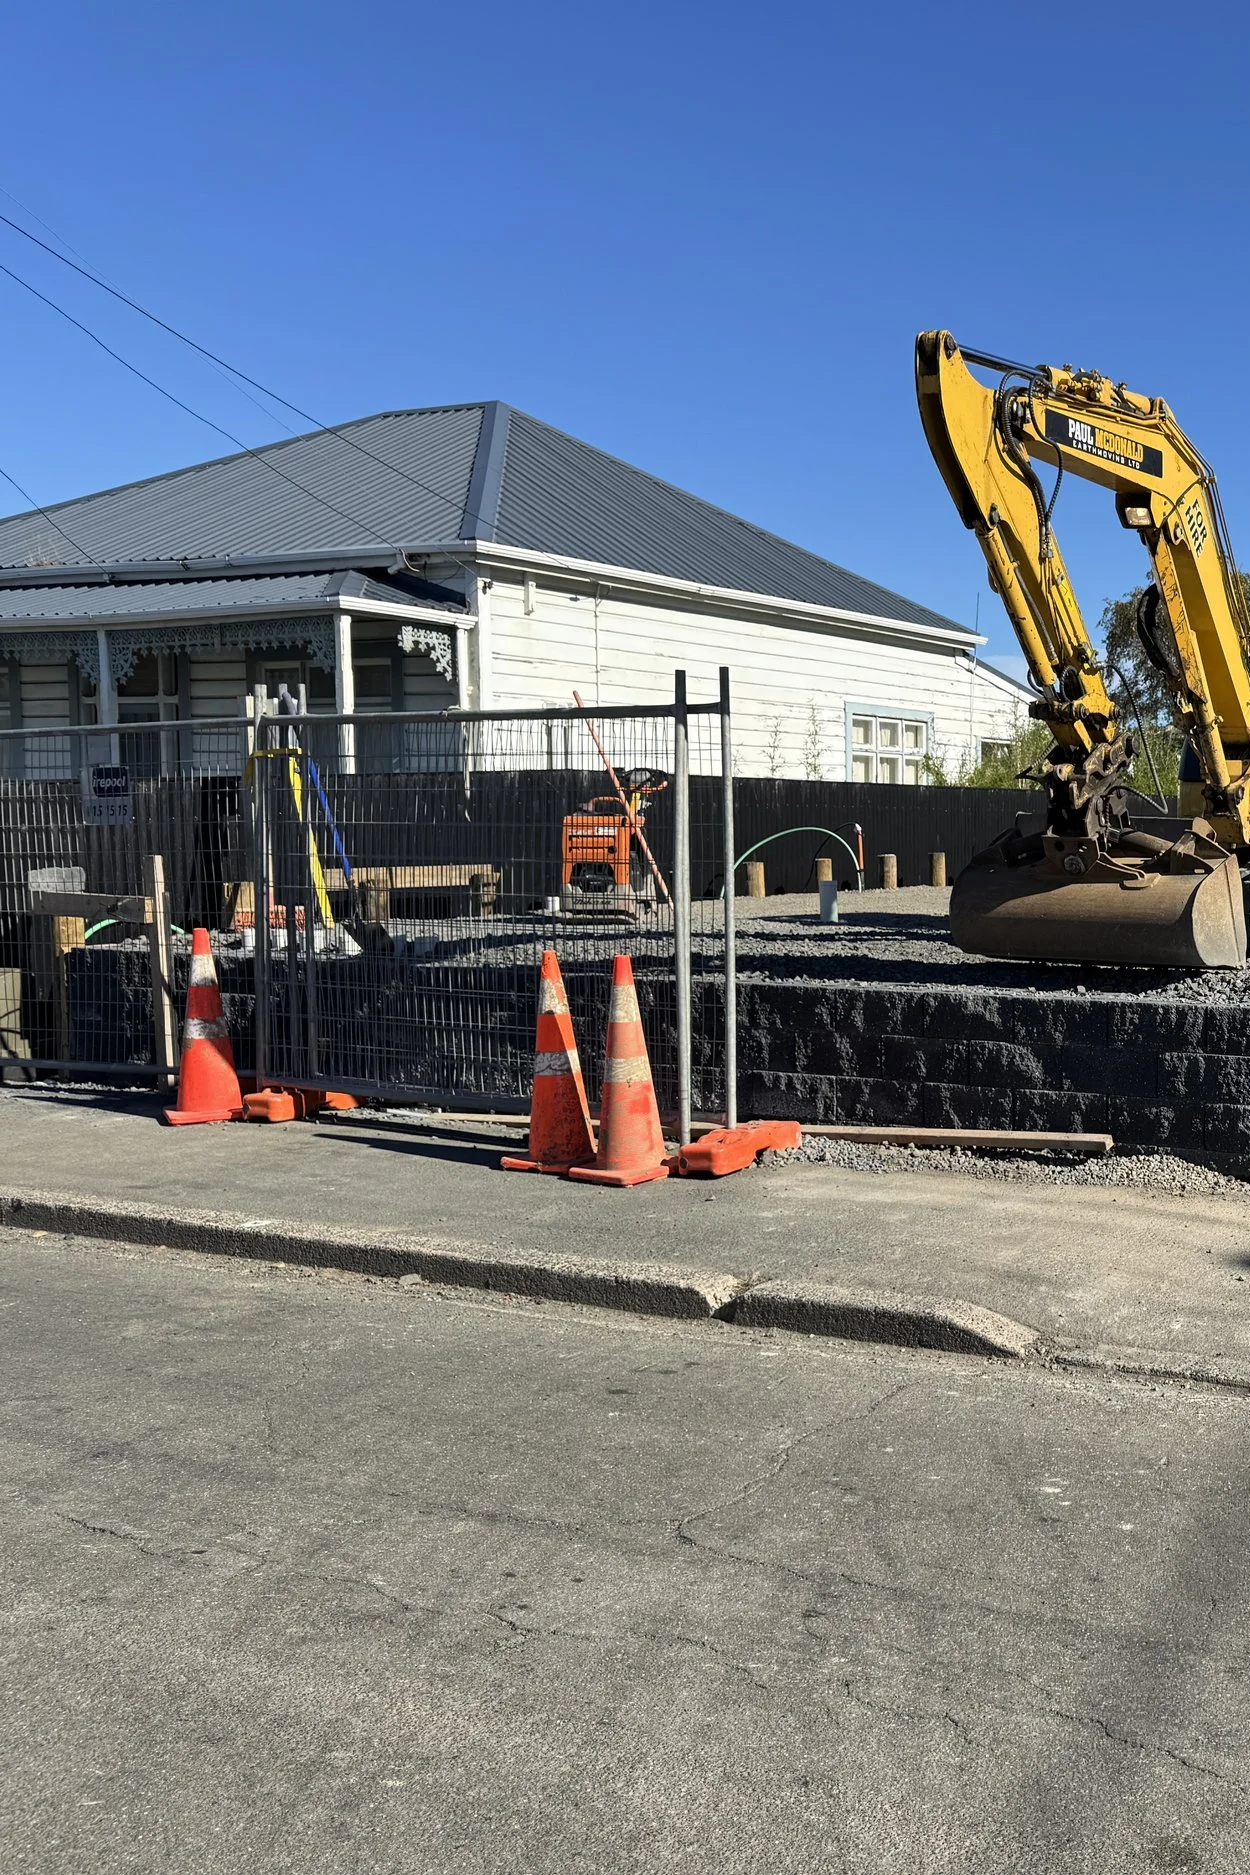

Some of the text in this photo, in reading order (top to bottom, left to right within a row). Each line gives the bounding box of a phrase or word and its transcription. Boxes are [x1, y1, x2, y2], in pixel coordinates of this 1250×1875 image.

[1068, 419, 1143, 462] PAUL MCDONALD
[1073, 440, 1140, 469] EARTHMOVING LTD
[1185, 505, 1203, 558] HIRE
[1192, 498, 1207, 543] FOR
[93, 776, 126, 790] irepool
